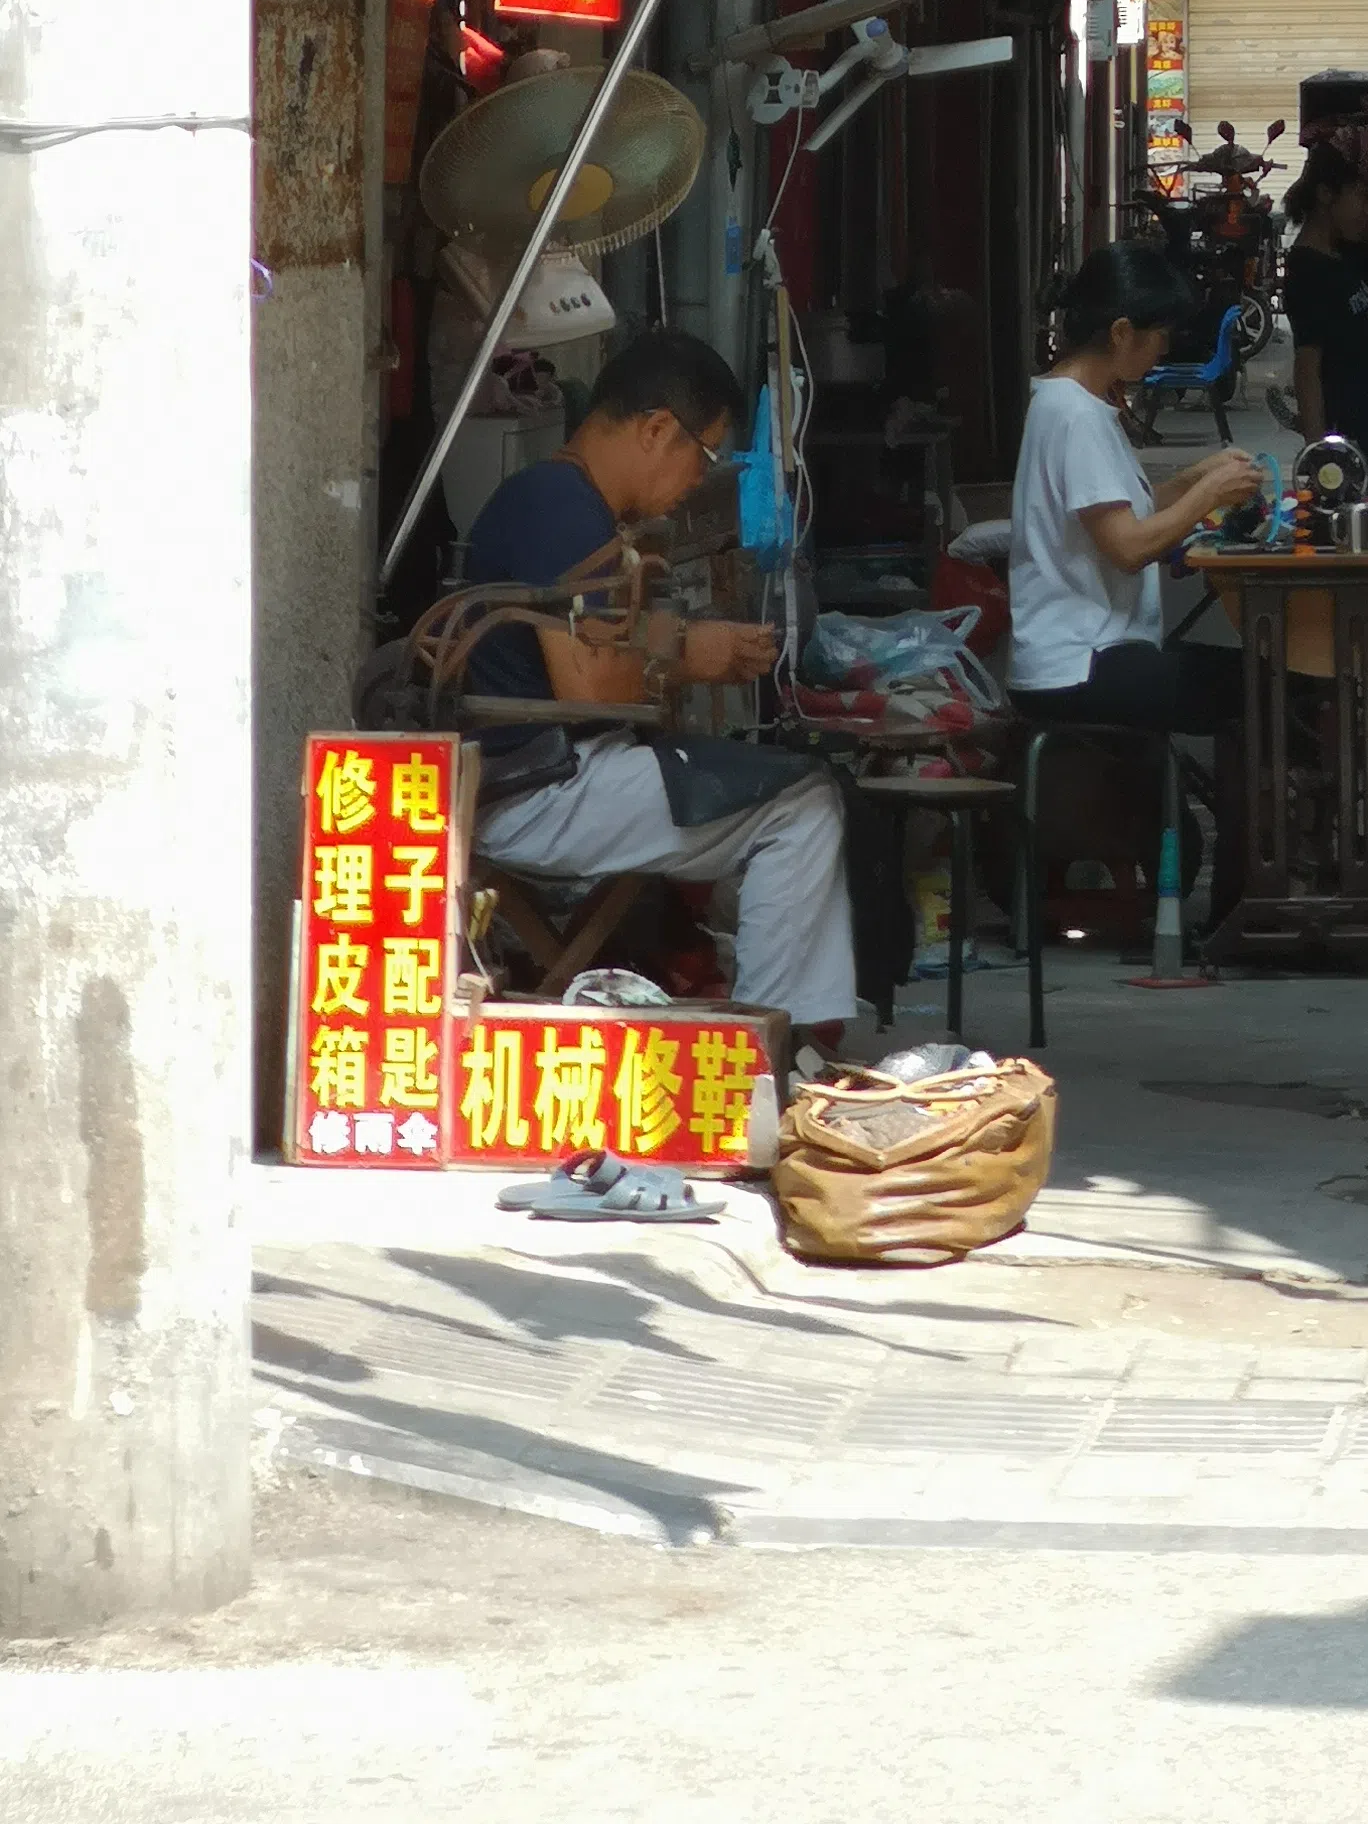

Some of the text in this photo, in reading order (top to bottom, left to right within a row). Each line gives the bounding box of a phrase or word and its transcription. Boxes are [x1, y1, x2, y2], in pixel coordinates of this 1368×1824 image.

[310, 750, 376, 1109] 修理皮箱
[381, 754, 445, 1108] 电子配匙
[308, 1112, 438, 1155] 修雨伞
[459, 1025, 757, 1155] 机械修鞋
